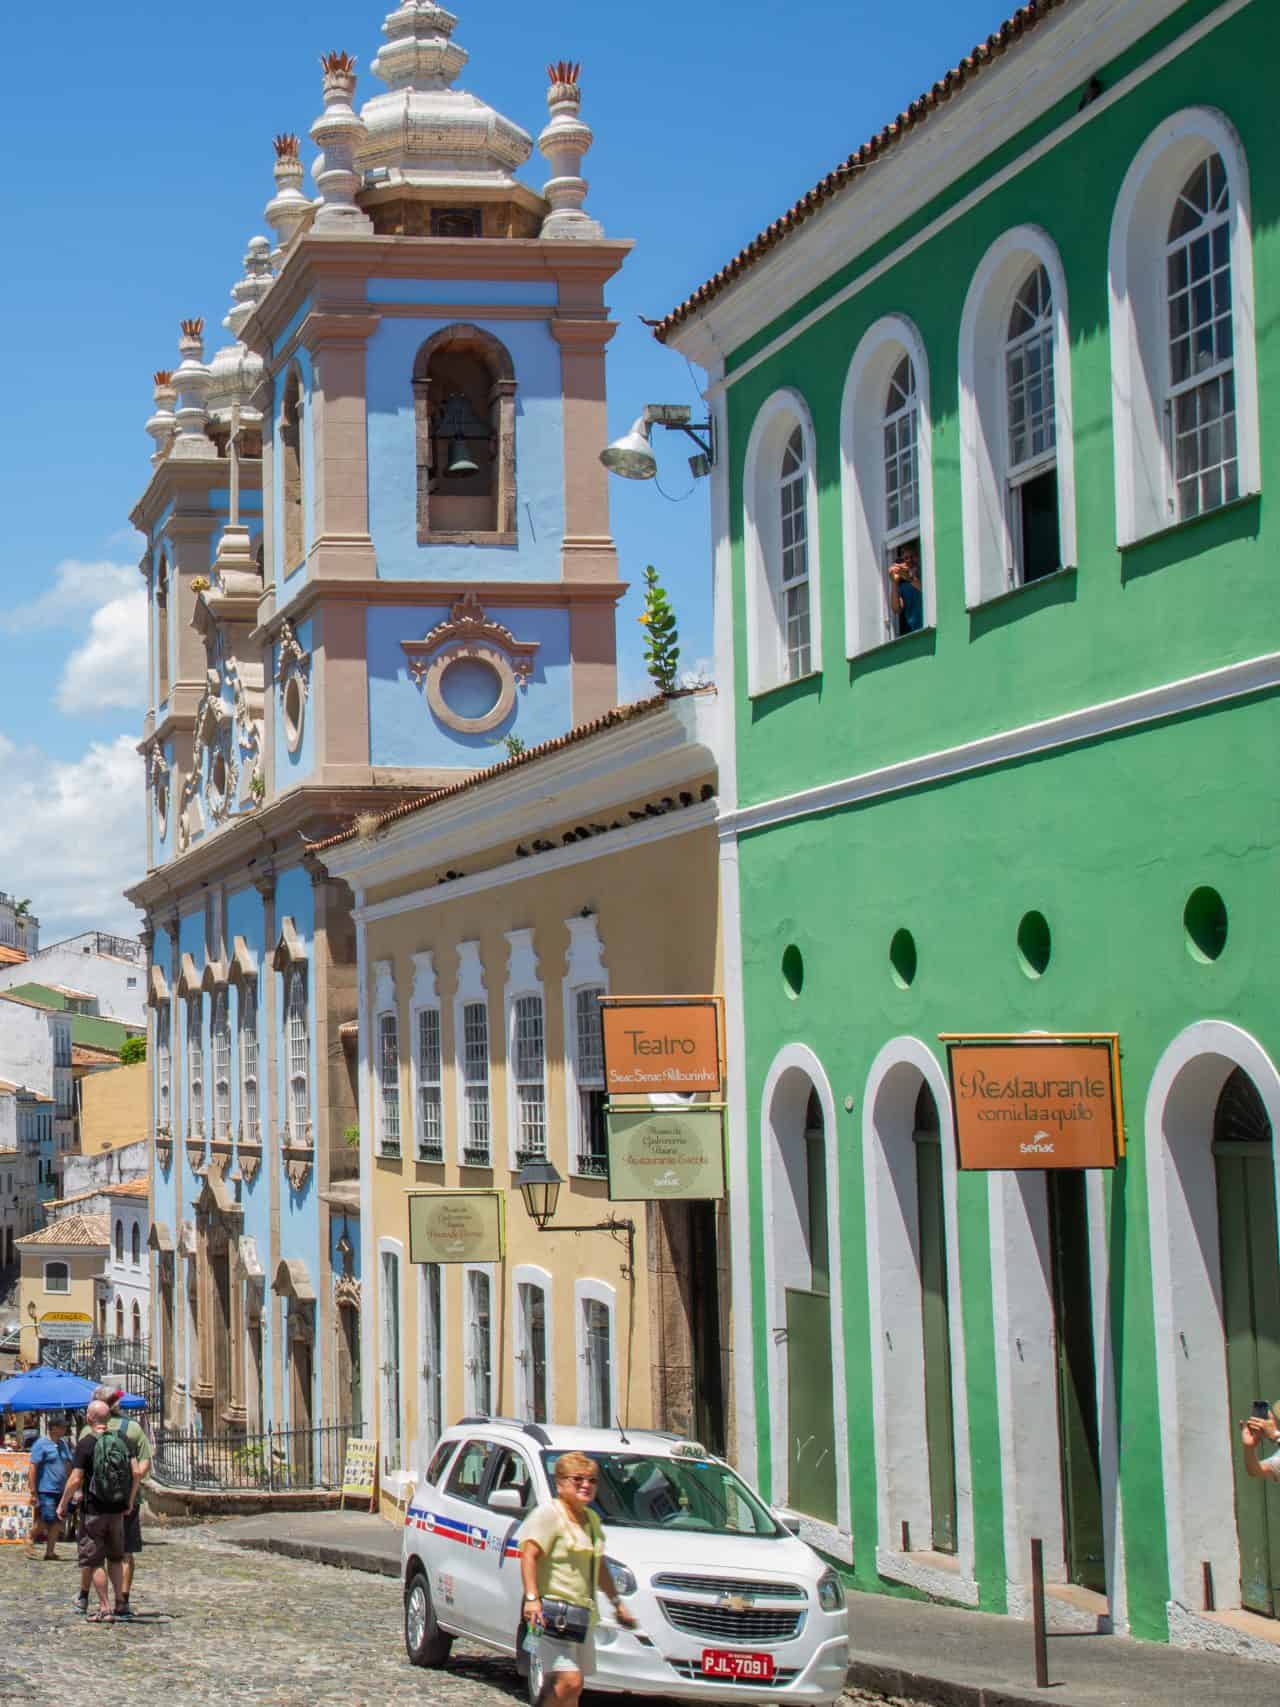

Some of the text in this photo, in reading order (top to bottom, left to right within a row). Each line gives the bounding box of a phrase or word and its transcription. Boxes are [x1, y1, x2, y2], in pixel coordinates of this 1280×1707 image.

[624, 1030, 695, 1056] Teatro
[959, 1069, 1105, 1099] Restaurante
[977, 1103, 1038, 1121] comida
